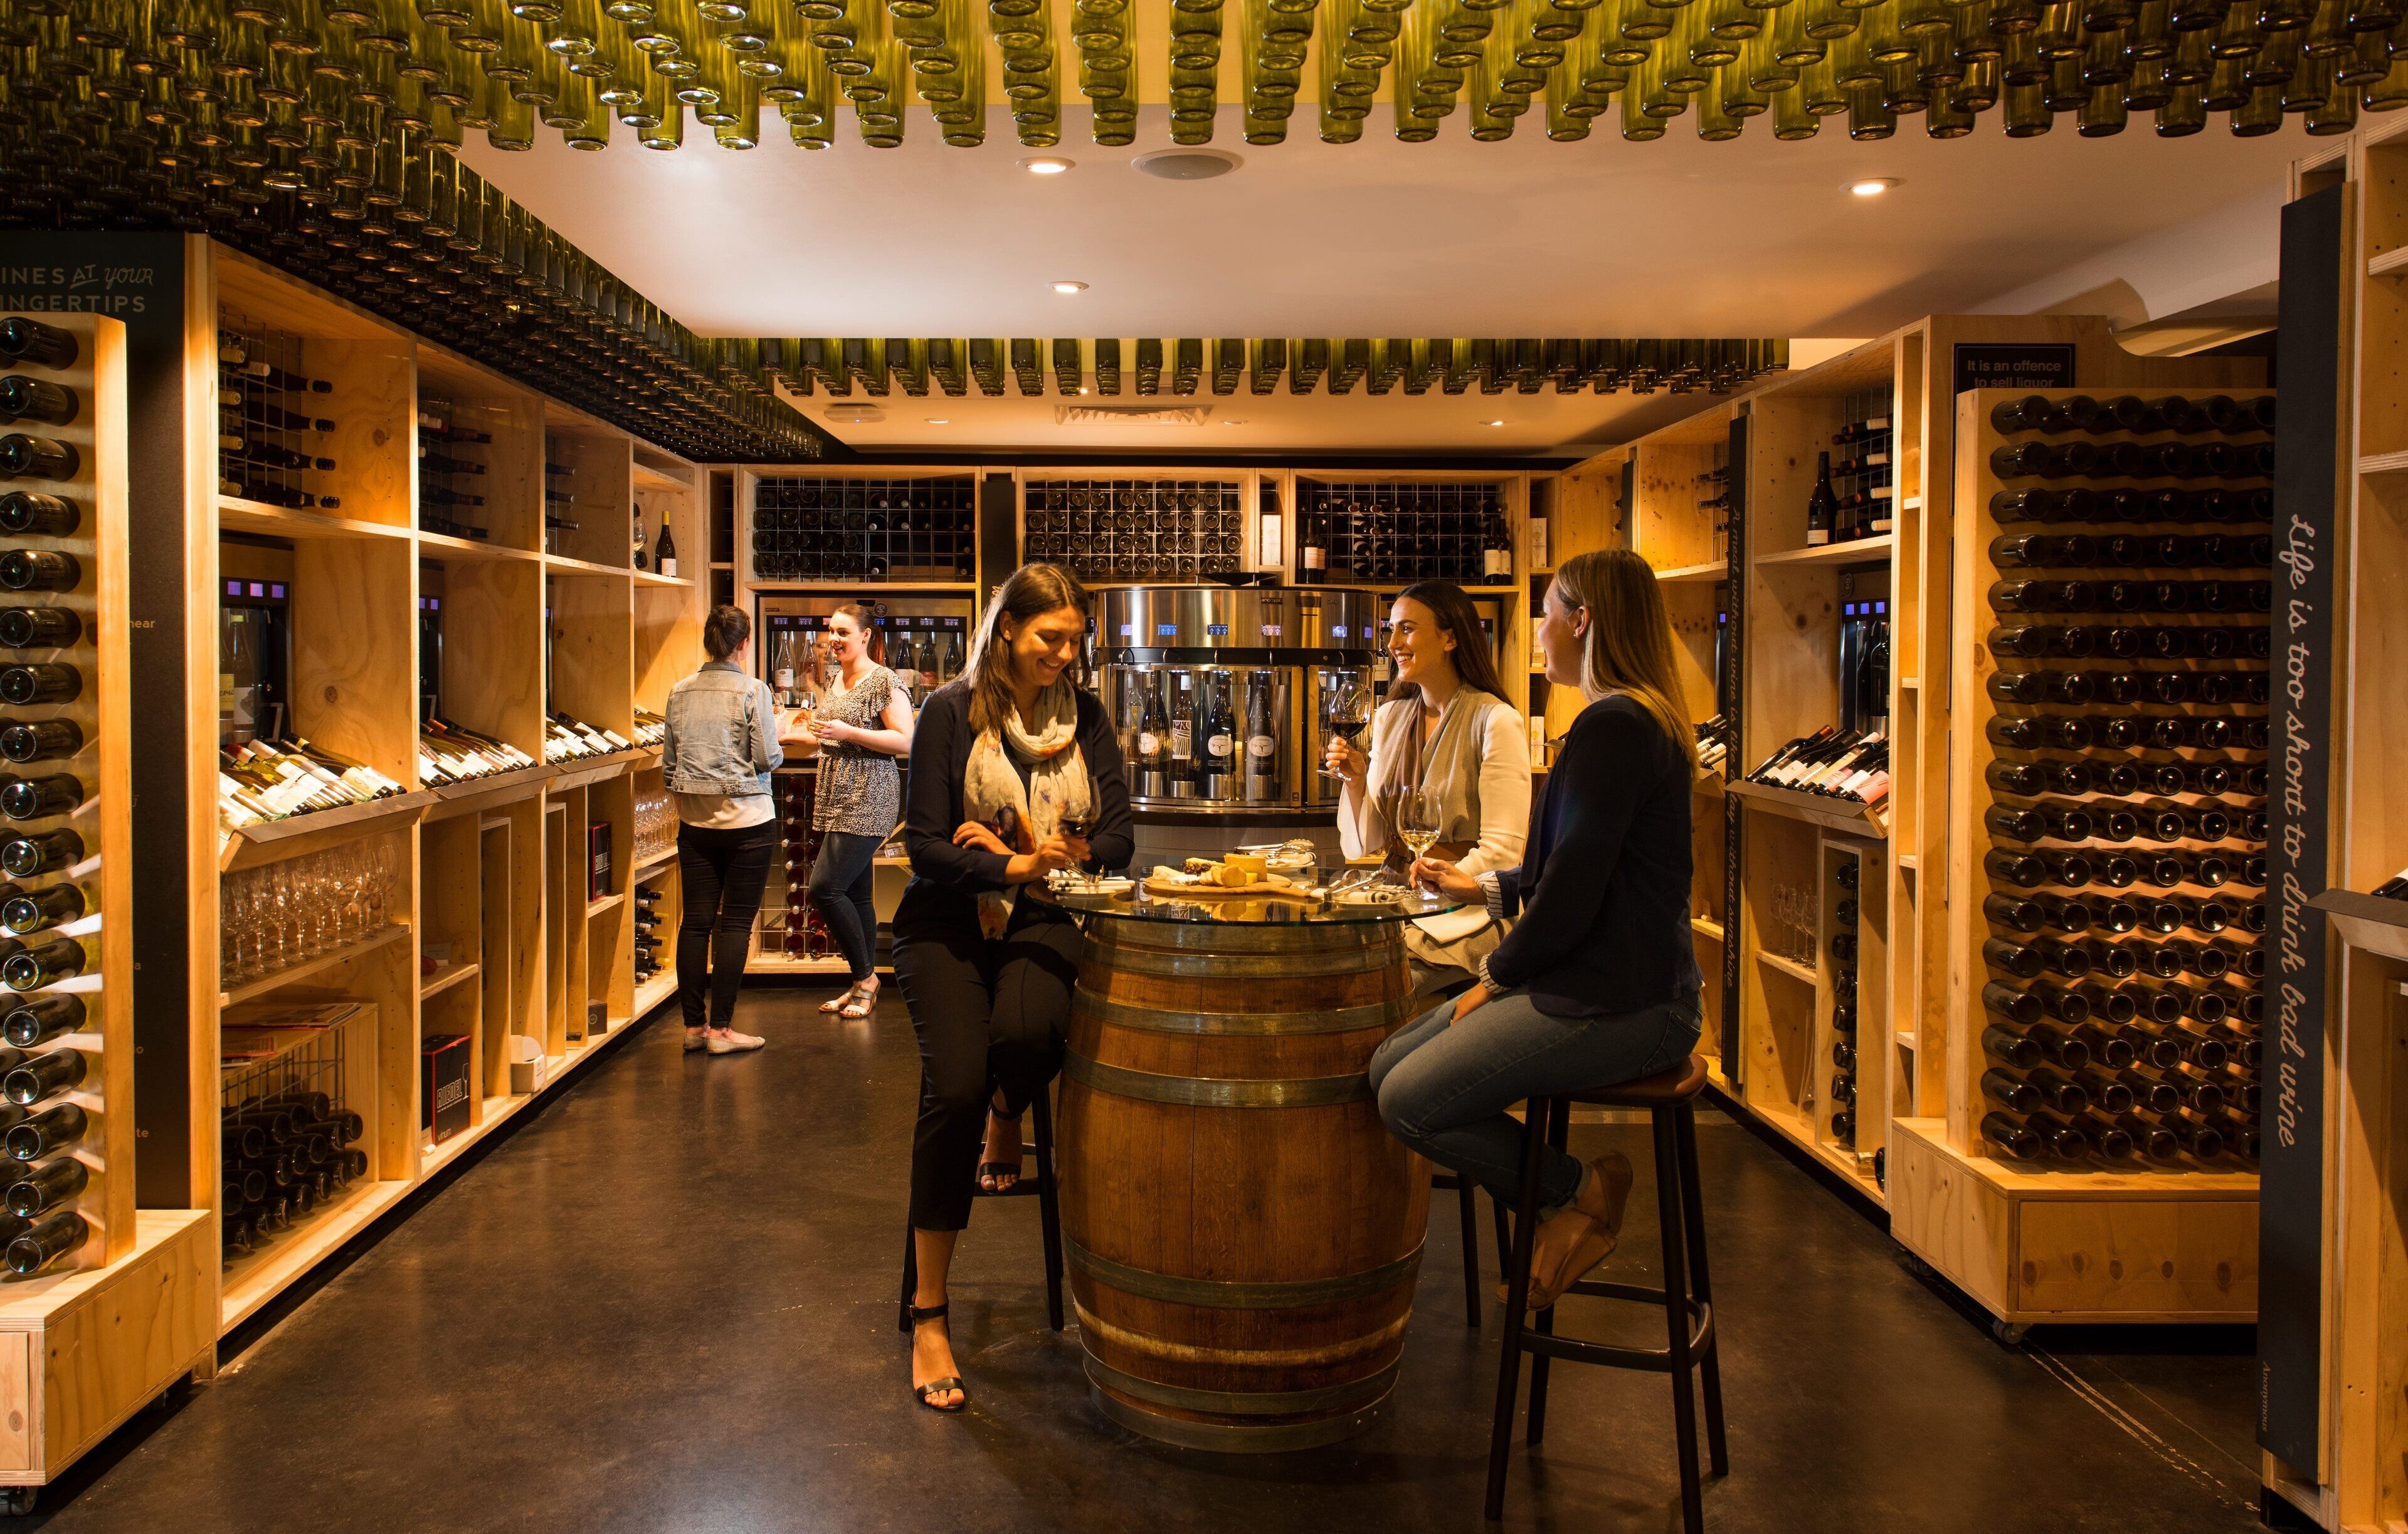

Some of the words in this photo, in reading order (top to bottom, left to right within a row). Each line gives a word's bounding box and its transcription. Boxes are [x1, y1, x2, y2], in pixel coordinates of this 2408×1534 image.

[71, 265, 98, 286] AT
[1967, 360, 1976, 371] It
[1979, 360, 1990, 372] is
[1993, 362, 2009, 371] an
[2013, 360, 2062, 372] offence
[1975, 378, 1987, 388] to
[1990, 377, 2012, 388] sell
[2016, 377, 2054, 388] liquor
[1731, 529, 1740, 575] meal
[2278, 513, 2315, 591] Life
[1731, 579, 1740, 653] without
[2288, 599, 2313, 635] is
[1730, 658, 1738, 701] wine
[2286, 641, 2310, 710] too
[1730, 707, 1738, 725] is
[1730, 730, 1738, 764] like
[2284, 710, 2311, 816] short
[1728, 830, 1737, 904] without
[2283, 823, 2306, 868] to
[1728, 906, 1736, 989] sunshine
[2281, 871, 2308, 974] drink
[2279, 982, 2306, 1059] bad
[436, 1078, 463, 1109] RIEDEL
[2277, 1062, 2303, 1148] wine
[2260, 1359, 2271, 1432] Anonymous
